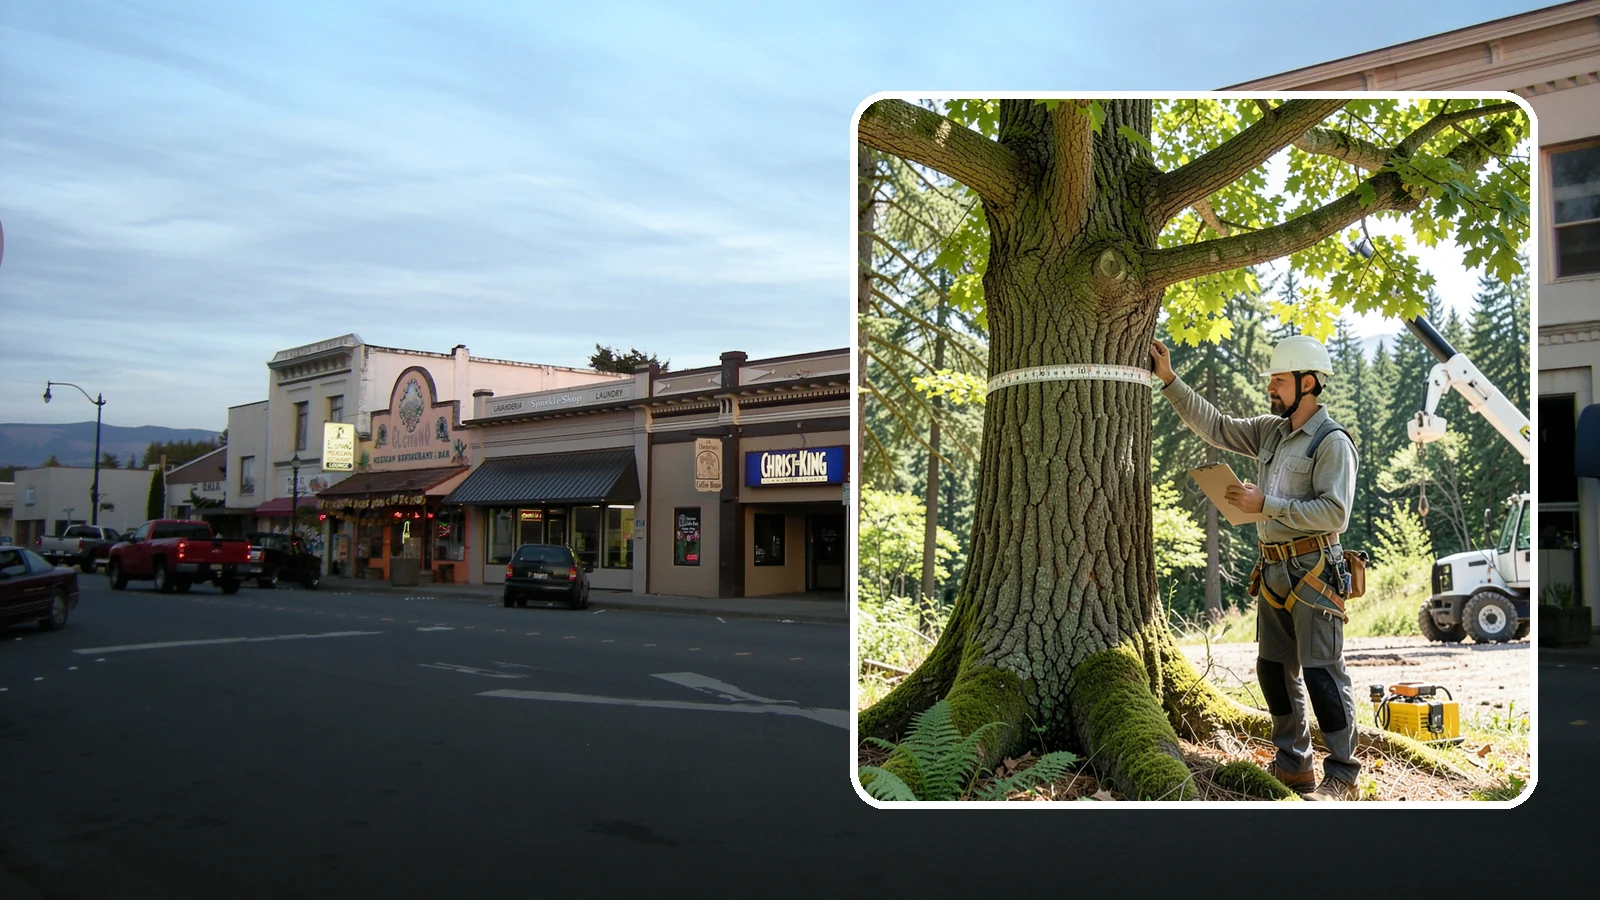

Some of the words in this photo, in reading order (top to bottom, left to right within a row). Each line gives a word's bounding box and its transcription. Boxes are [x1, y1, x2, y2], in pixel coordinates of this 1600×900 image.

[596, 389, 623, 399] LAUNDRY
[494, 402, 522, 412] LAVANDERIA
[531, 396, 560, 409] Sparkle
[561, 394, 582, 407] Shop
[373, 455, 396, 463] MEXICAN
[397, 451, 433, 462] RESTAURANT
[438, 450, 450, 458] BAR
[761, 452, 797, 478] CHRIST
[799, 450, 827, 476] KING
